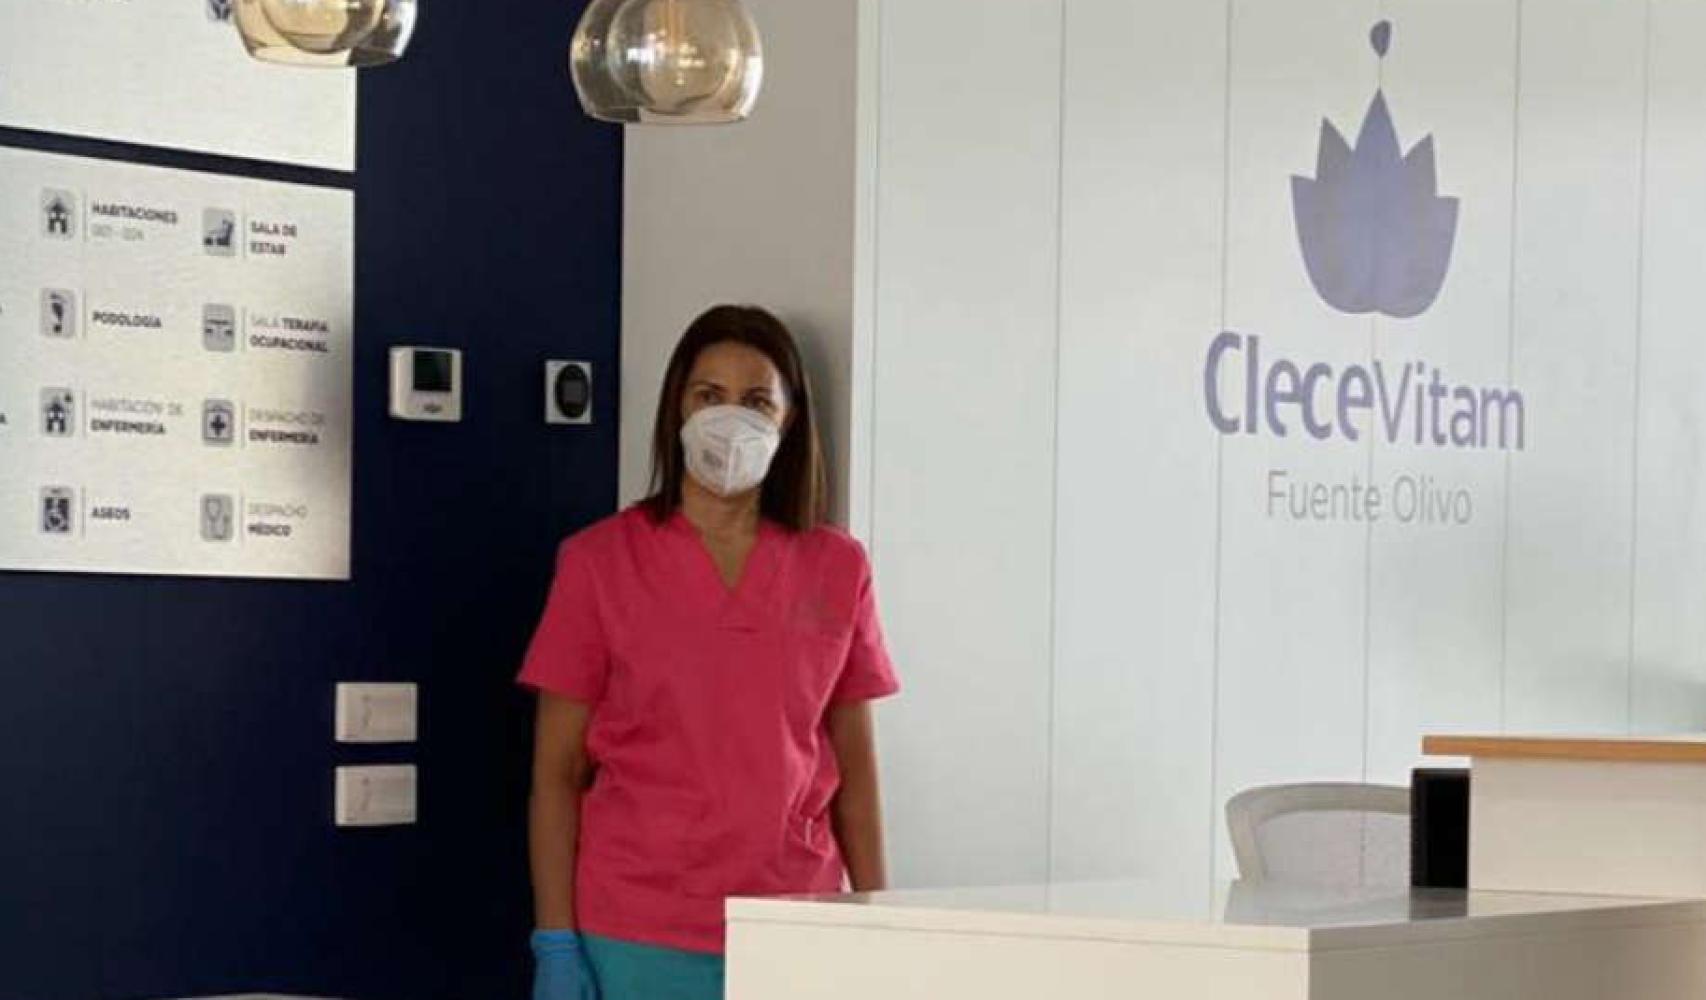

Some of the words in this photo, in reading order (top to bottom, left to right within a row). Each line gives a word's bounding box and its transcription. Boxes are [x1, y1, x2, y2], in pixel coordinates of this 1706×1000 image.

[251, 221, 280, 235] SALA
[282, 224, 297, 237] DE
[1203, 330, 1526, 450] CleceVitam
[1267, 470, 1382, 522] Fuente
[1393, 475, 1473, 525] Olivo
